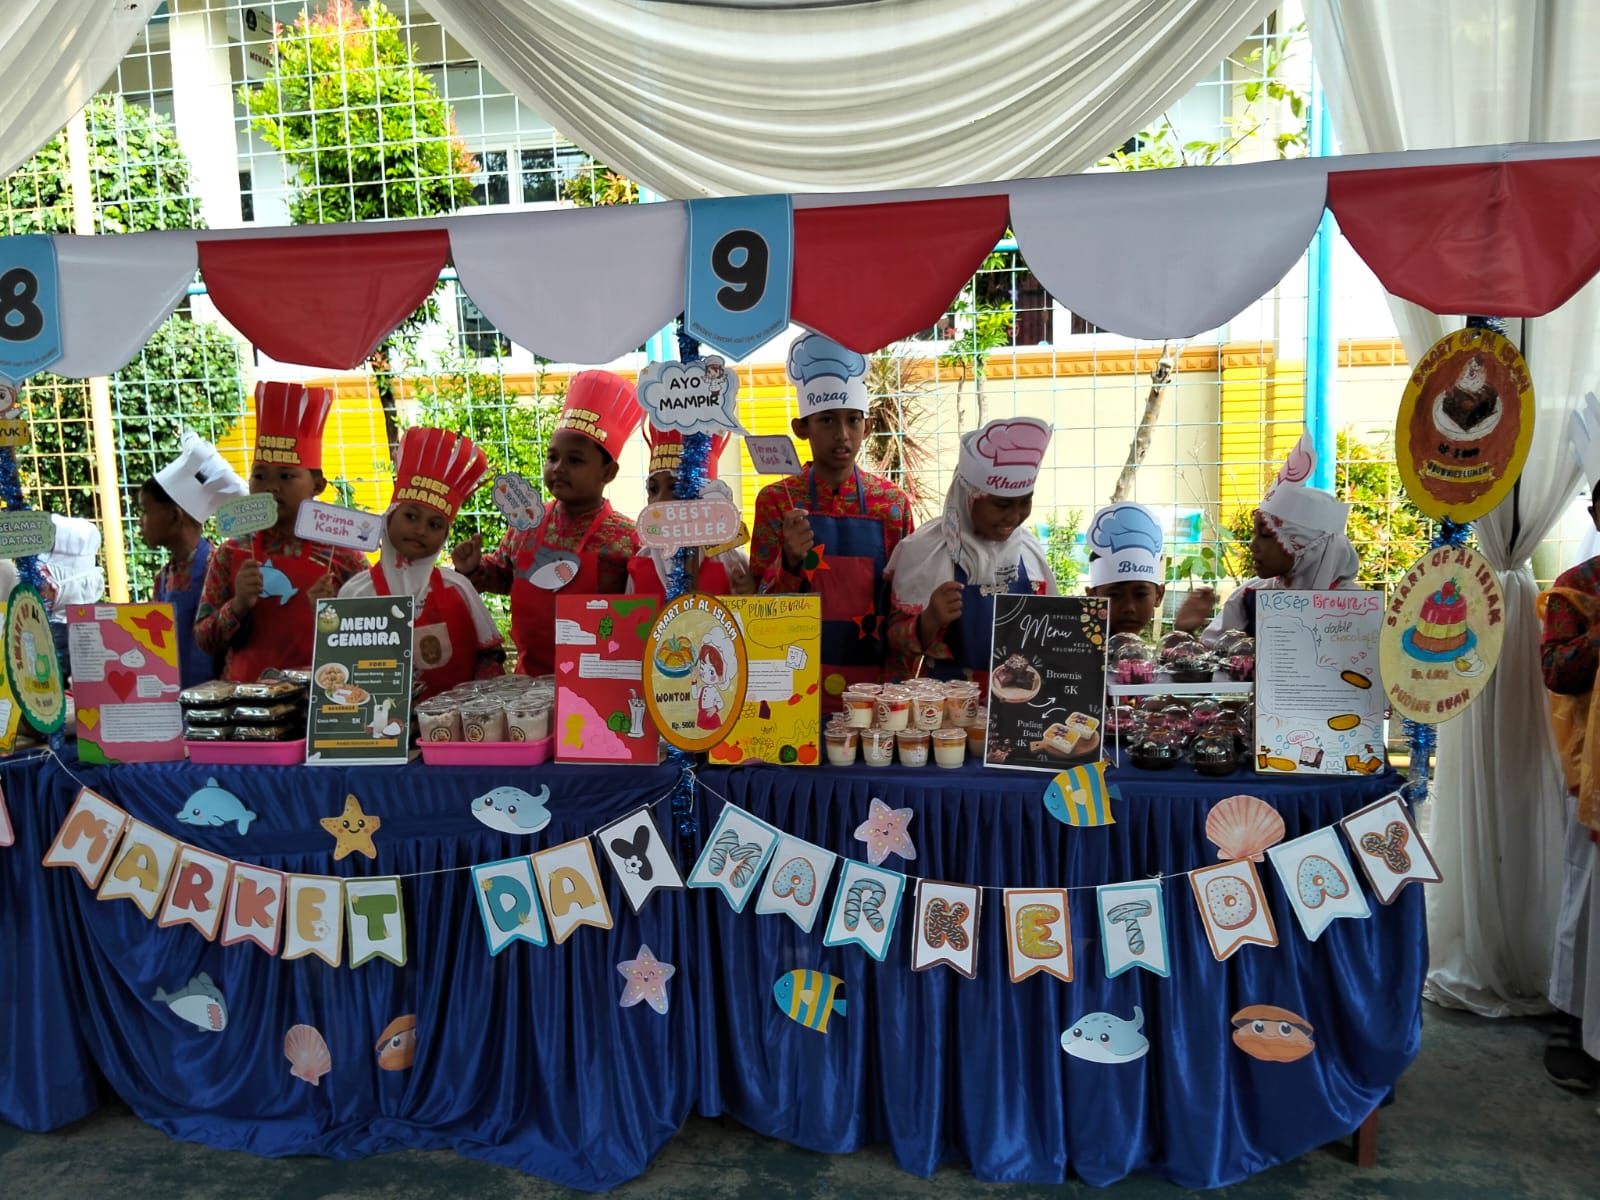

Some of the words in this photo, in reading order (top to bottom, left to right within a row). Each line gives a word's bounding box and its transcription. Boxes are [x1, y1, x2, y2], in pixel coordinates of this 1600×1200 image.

[710, 228, 770, 314] 9
[0, 267, 43, 342] 8
[669, 376, 701, 390] AYO
[659, 394, 720, 411] MAMPIR
[259, 435, 297, 449] CHEF
[255, 448, 301, 465] AQEEL
[410, 475, 450, 495] CHEF
[397, 487, 452, 516] AMANDA
[312, 508, 355, 527] Terima
[665, 505, 712, 522] BEST
[314, 522, 349, 536] Kasih
[661, 521, 727, 539] SELLER
[1, 535, 43, 546] DATANG
[1118, 560, 1154, 574] Bram
[1387, 562, 1426, 627] SMART
[1431, 549, 1450, 568] OF
[1454, 550, 1474, 569] AL
[340, 616, 388, 631] MENU
[653, 604, 680, 641] SMART
[683, 598, 695, 610] OF
[698, 600, 710, 612] AL
[712, 606, 737, 641] ISLAM
[327, 631, 401, 647] GEMBIRA
[1020, 614, 1073, 648] Menu
[1046, 669, 1082, 680] Brownis
[655, 691, 691, 703] WONTON
[1064, 685, 1079, 695] 5K
[62, 809, 397, 942] MARKET
[484, 824, 654, 932] DAY
[708, 828, 1152, 960] MARKET
[1205, 820, 1412, 931] DAY
